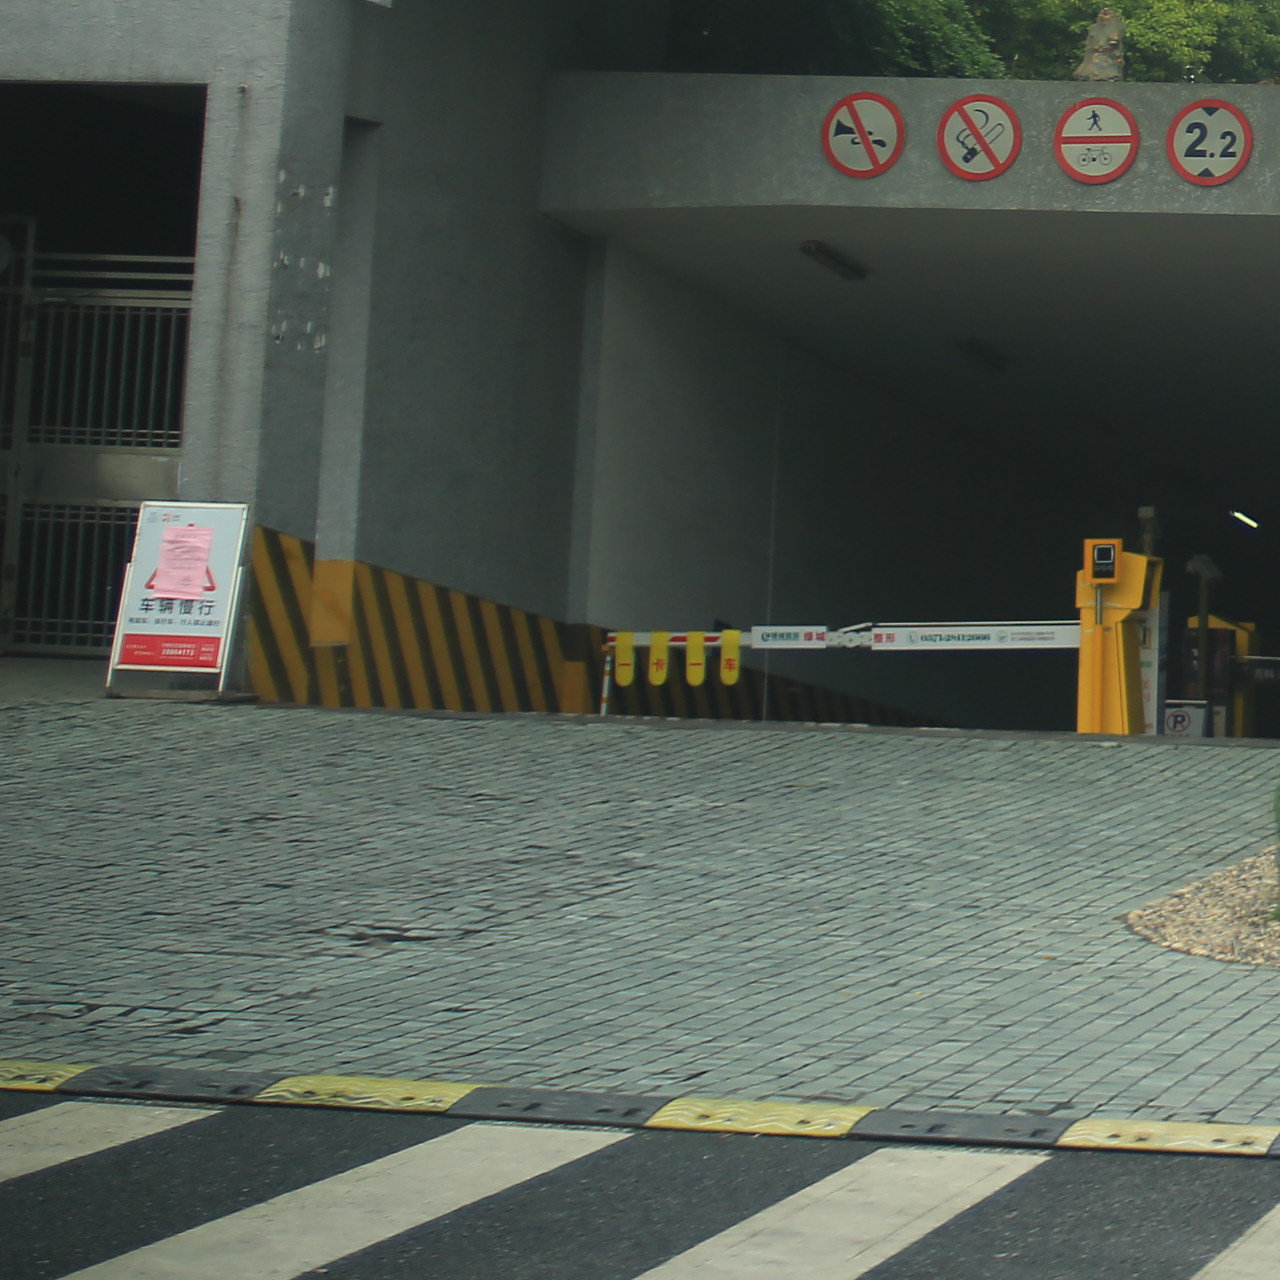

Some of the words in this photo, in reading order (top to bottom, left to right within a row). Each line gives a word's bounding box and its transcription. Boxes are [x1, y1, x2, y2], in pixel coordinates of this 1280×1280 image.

[1183, 121, 1237, 159] 2.2
[138, 597, 218, 616] 车辆慢行
